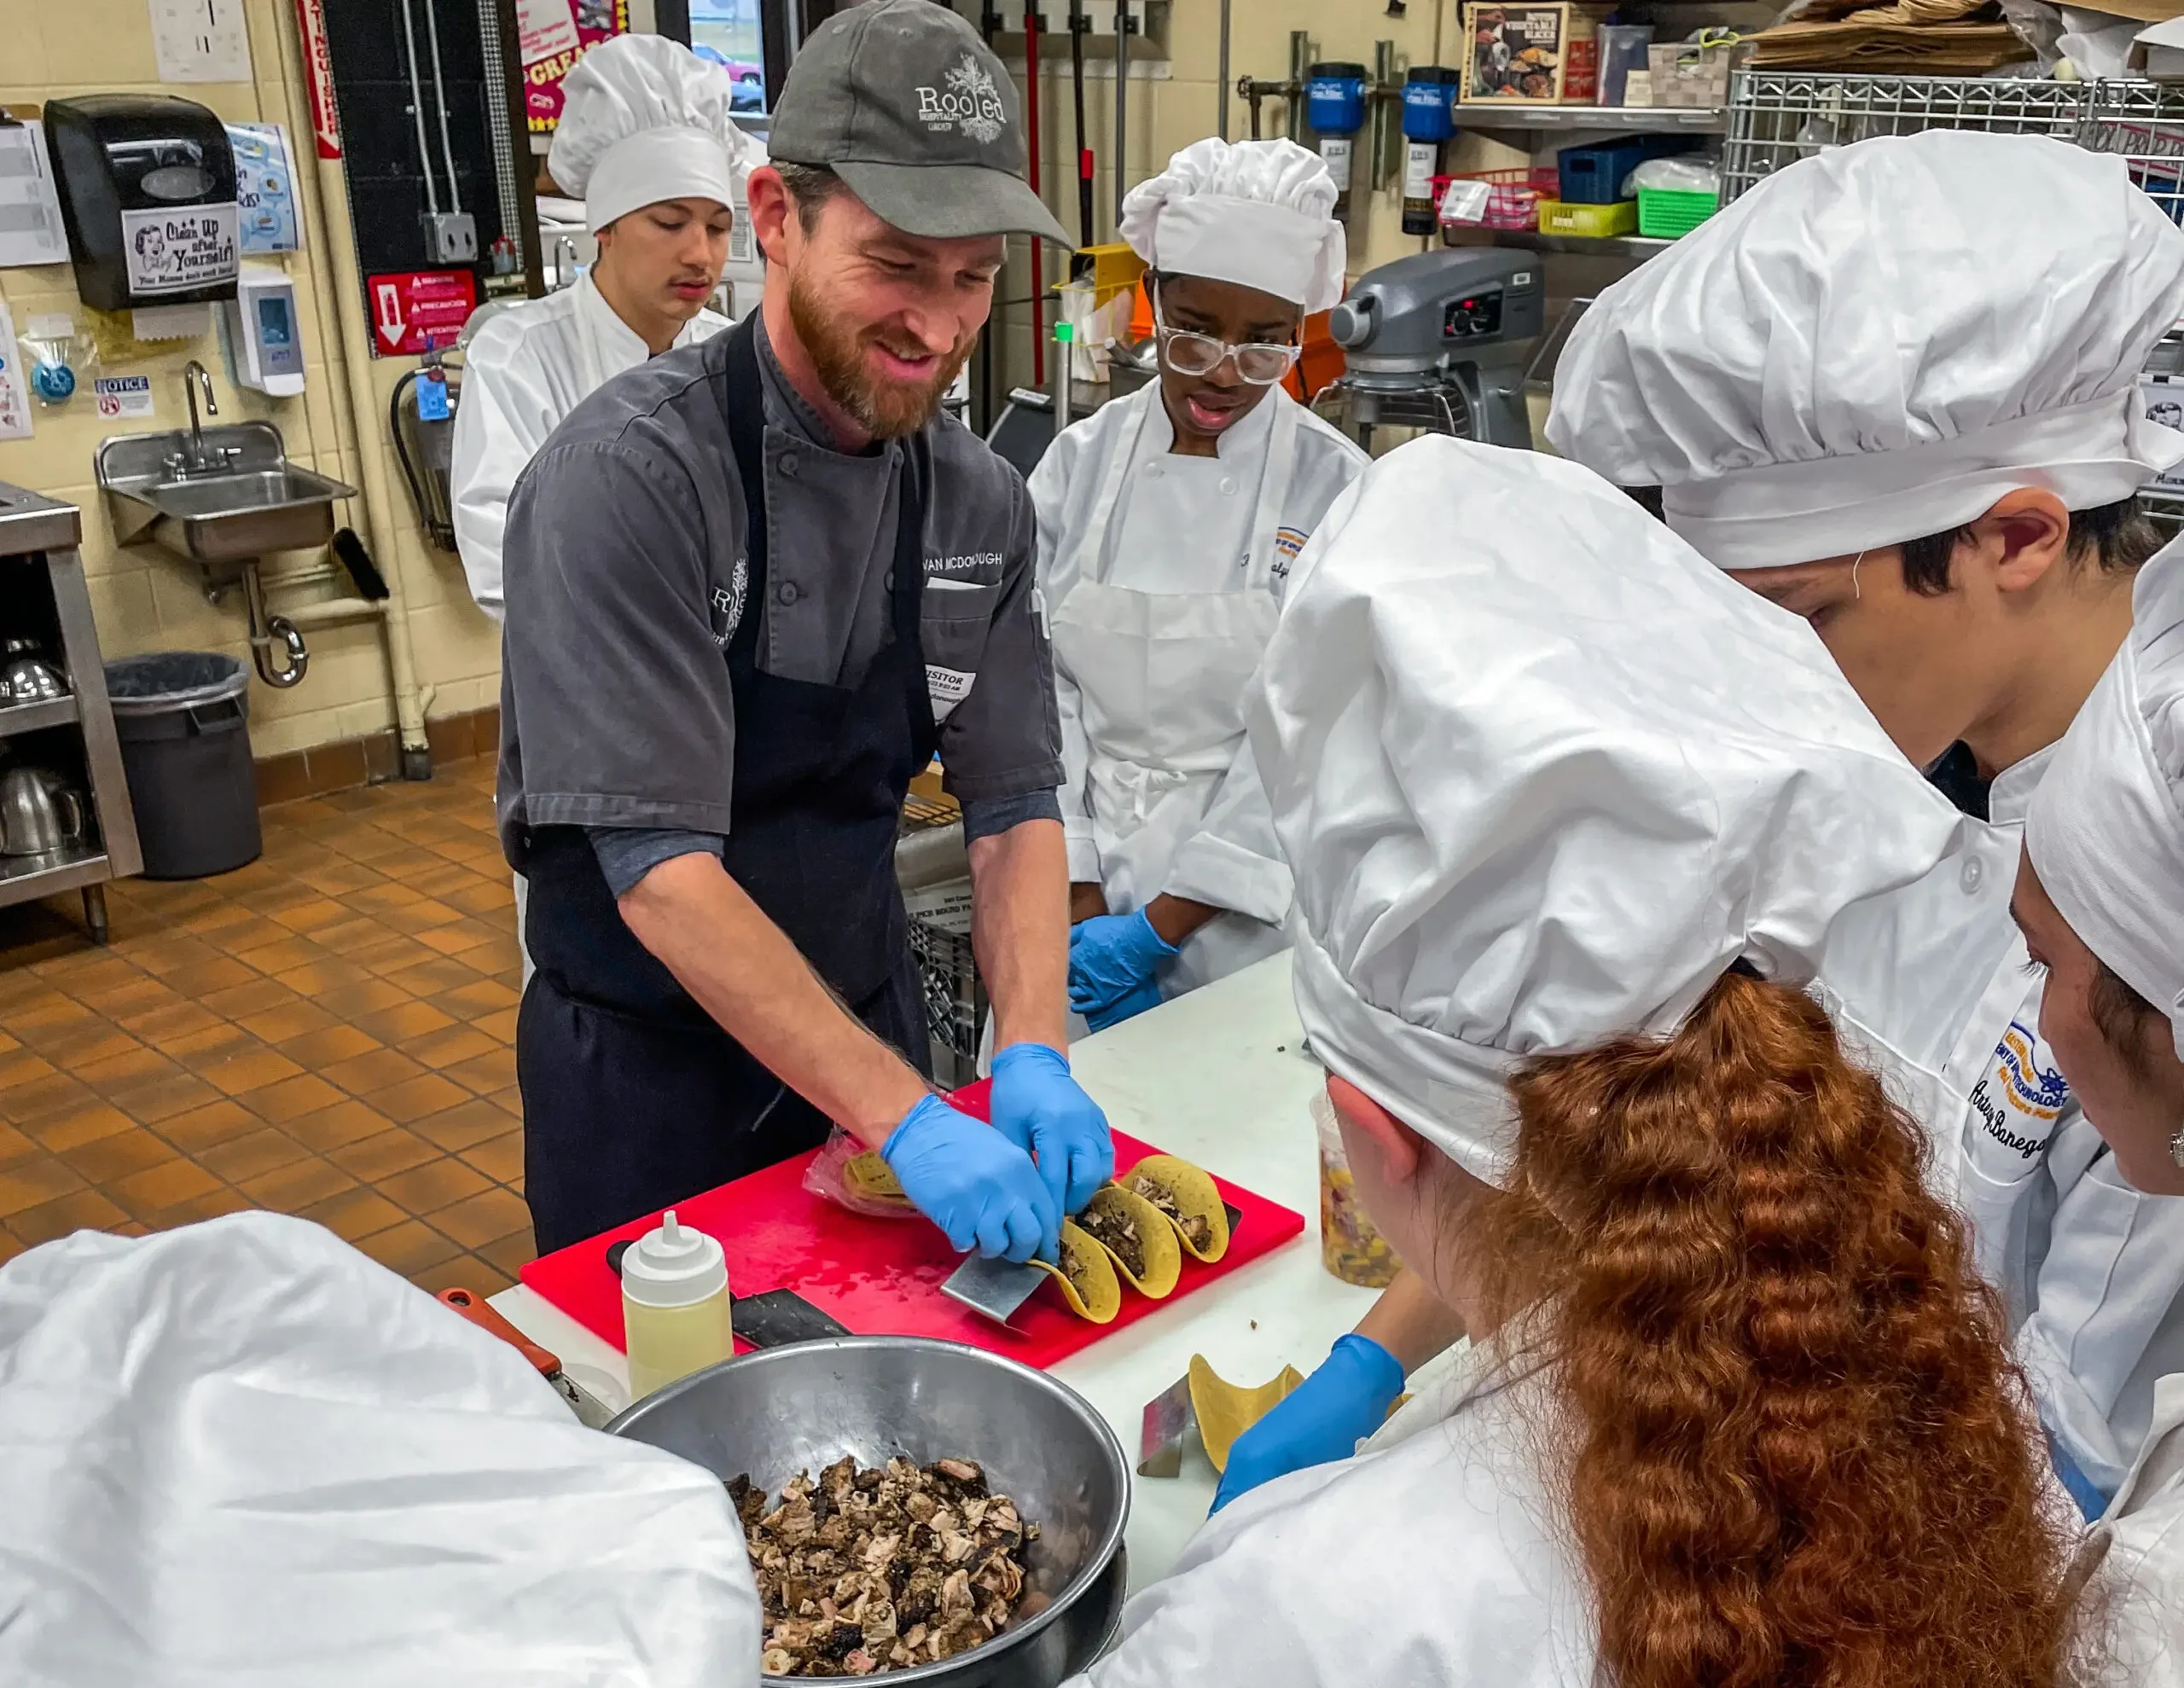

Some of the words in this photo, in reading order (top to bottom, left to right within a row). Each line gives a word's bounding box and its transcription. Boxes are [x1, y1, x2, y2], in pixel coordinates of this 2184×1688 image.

[915, 86, 1007, 124] Rooted
[922, 557, 943, 571] VAN
[925, 670, 963, 686] ISITOR
